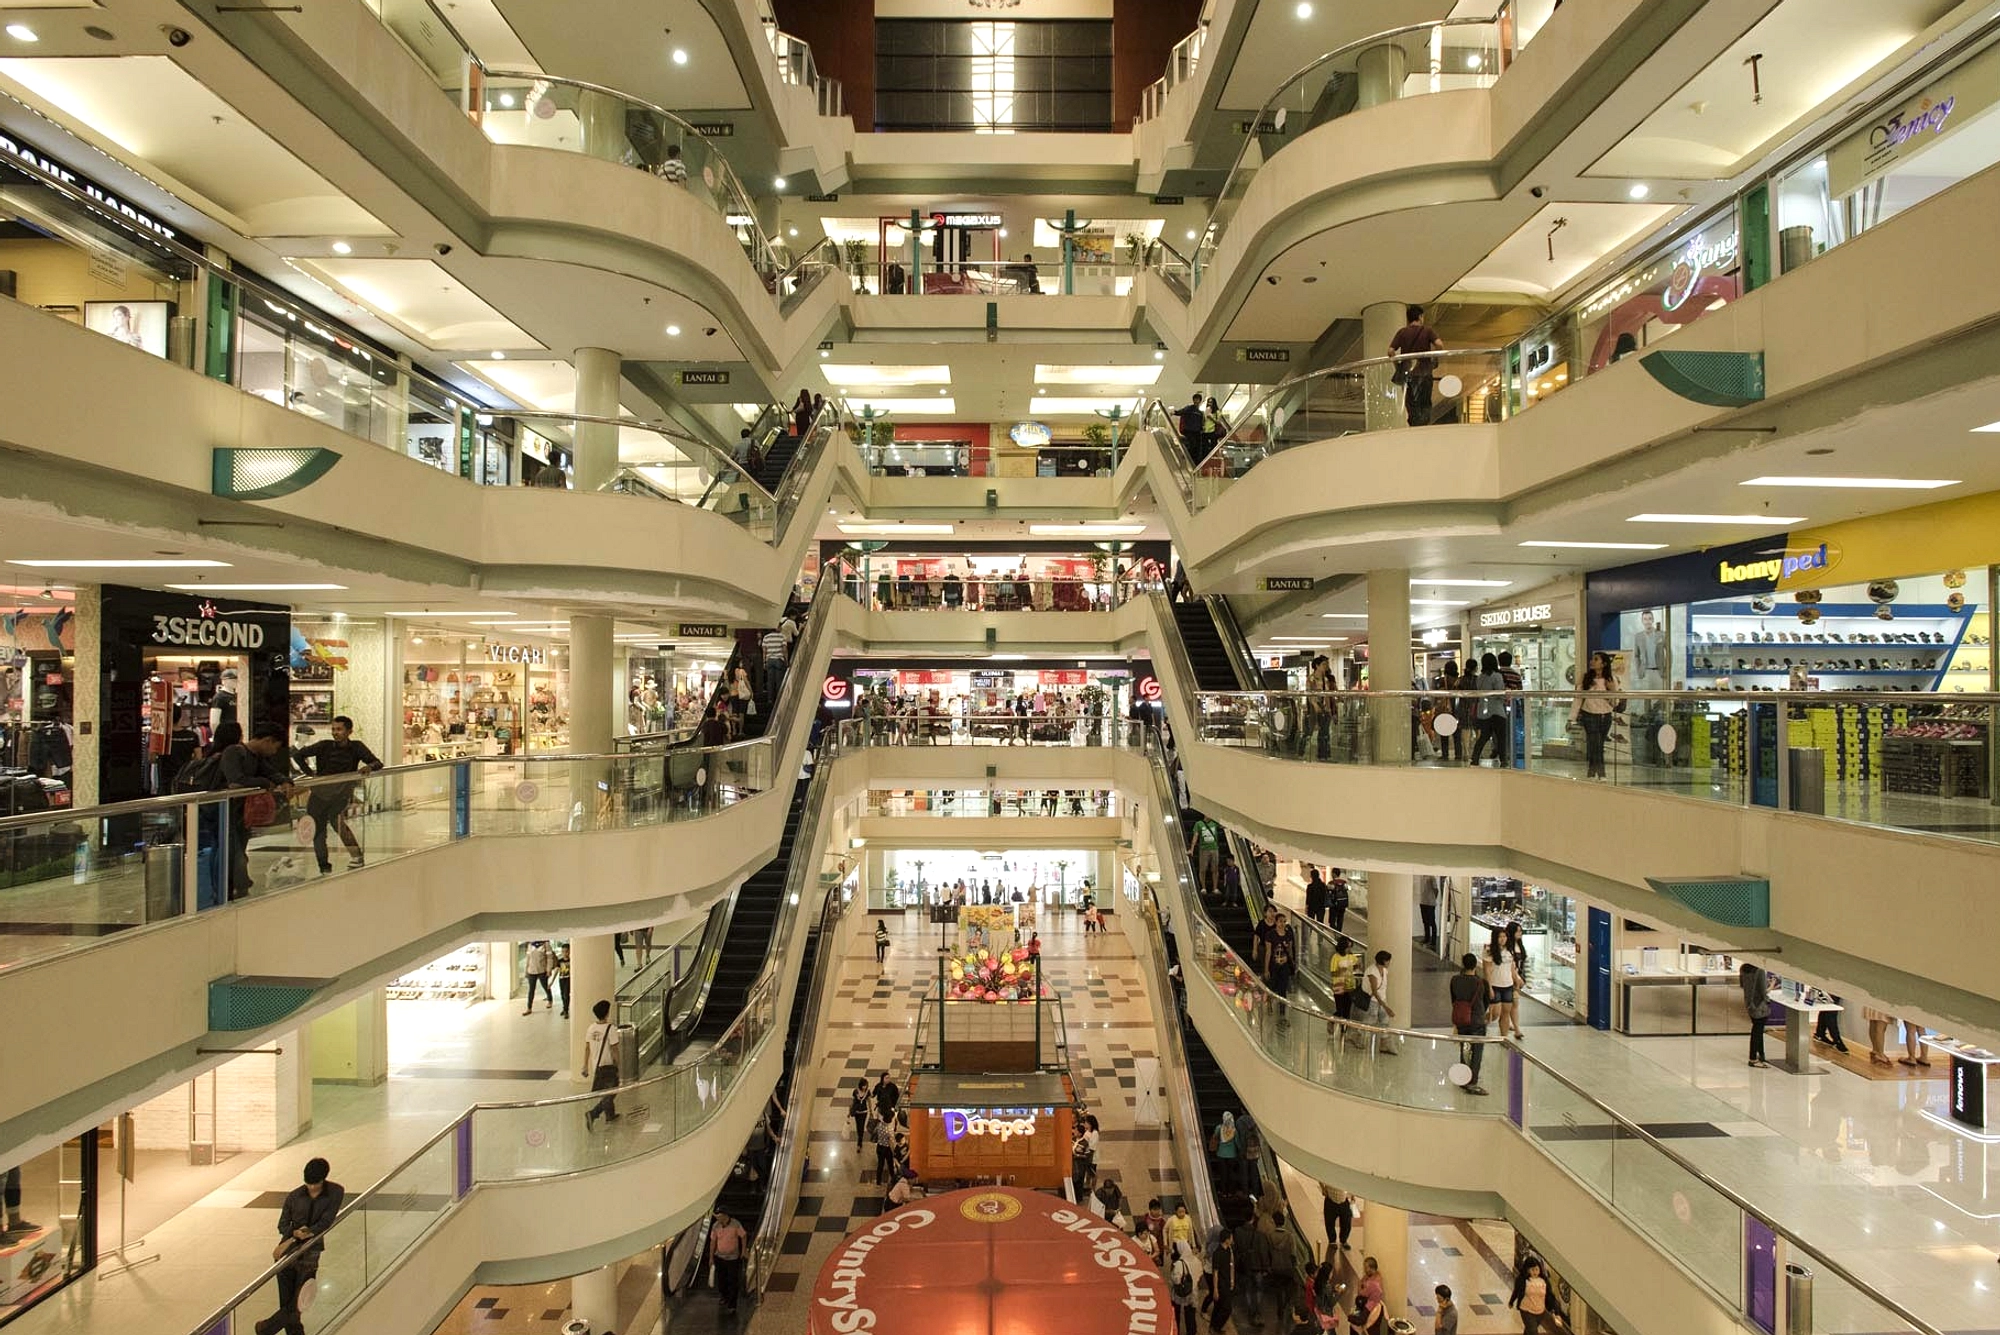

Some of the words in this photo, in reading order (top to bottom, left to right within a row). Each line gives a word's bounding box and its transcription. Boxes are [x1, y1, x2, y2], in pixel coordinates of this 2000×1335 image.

[1249, 351, 1278, 360] LANTAI
[686, 374, 716, 382] LANTAI
[1270, 580, 1300, 589] LANTAI
[1480, 610, 1511, 627] SEIKO
[1512, 604, 1552, 623] HOUSE
[151, 615, 264, 649] 3SECOND
[683, 627, 713, 636] LANTAI
[490, 645, 547, 665] VICARI
[1955, 1066, 1964, 1113] lenovo
